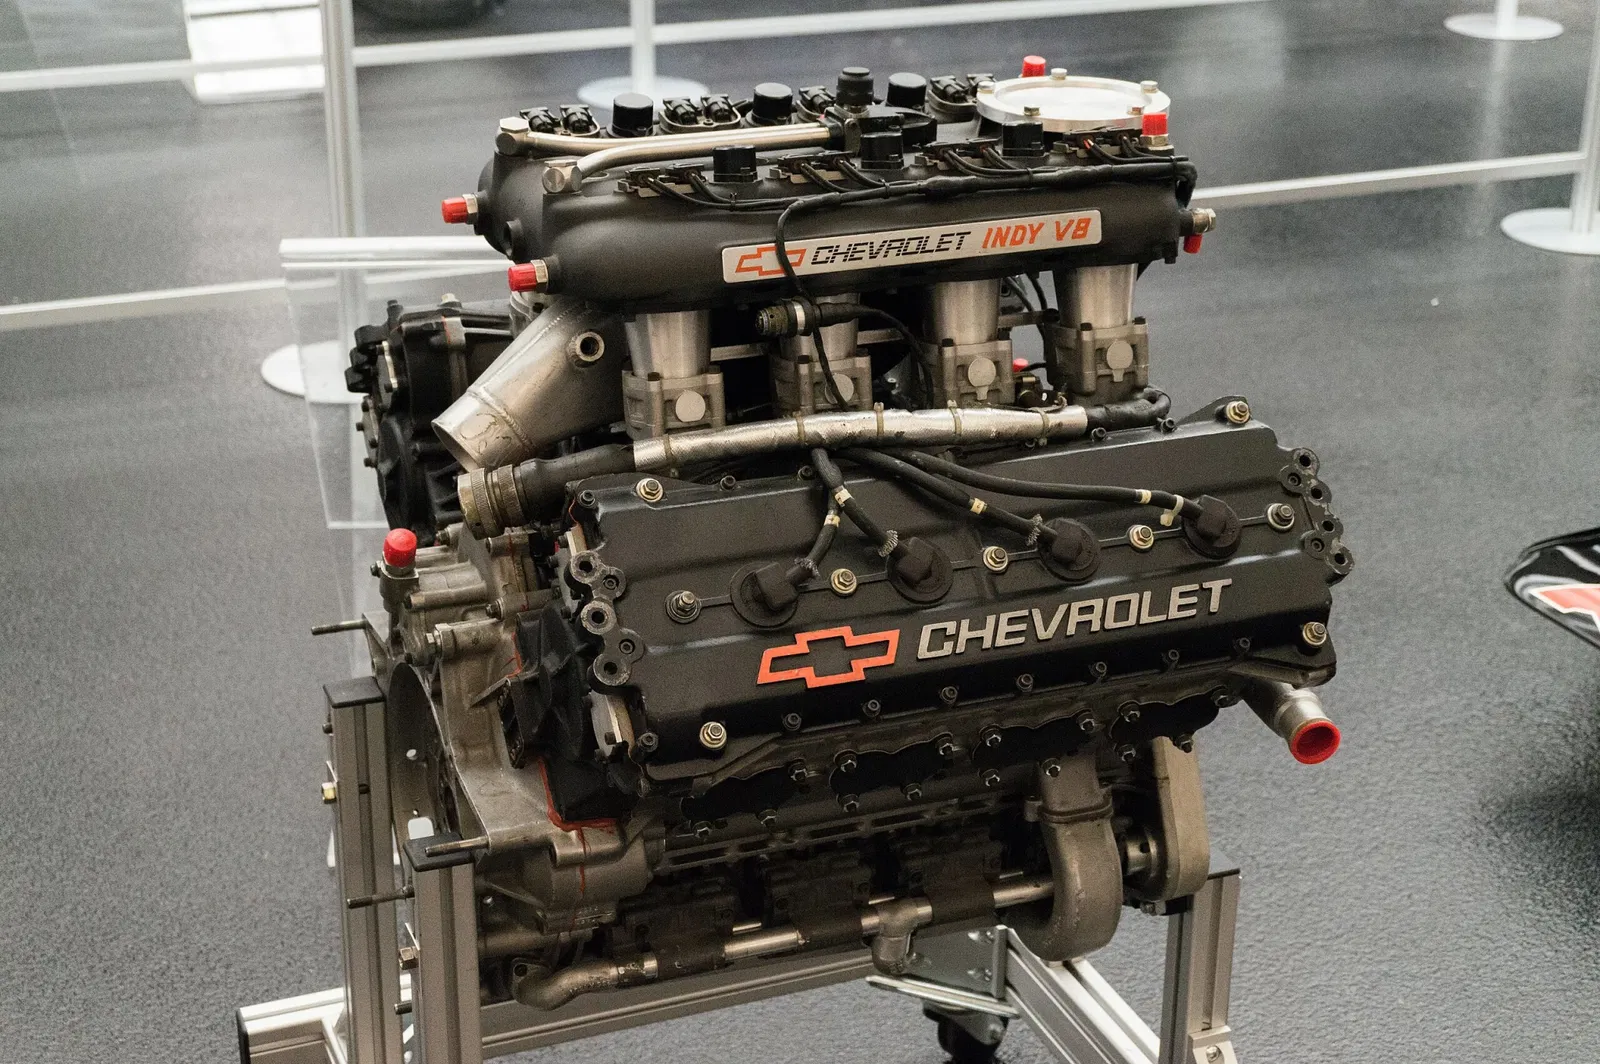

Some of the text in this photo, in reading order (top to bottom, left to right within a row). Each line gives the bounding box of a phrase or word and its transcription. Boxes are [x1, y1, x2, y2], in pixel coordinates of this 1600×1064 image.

[810, 217, 1093, 266] CHEVROLET INDY V8
[917, 578, 1233, 660] CHEVROLET
